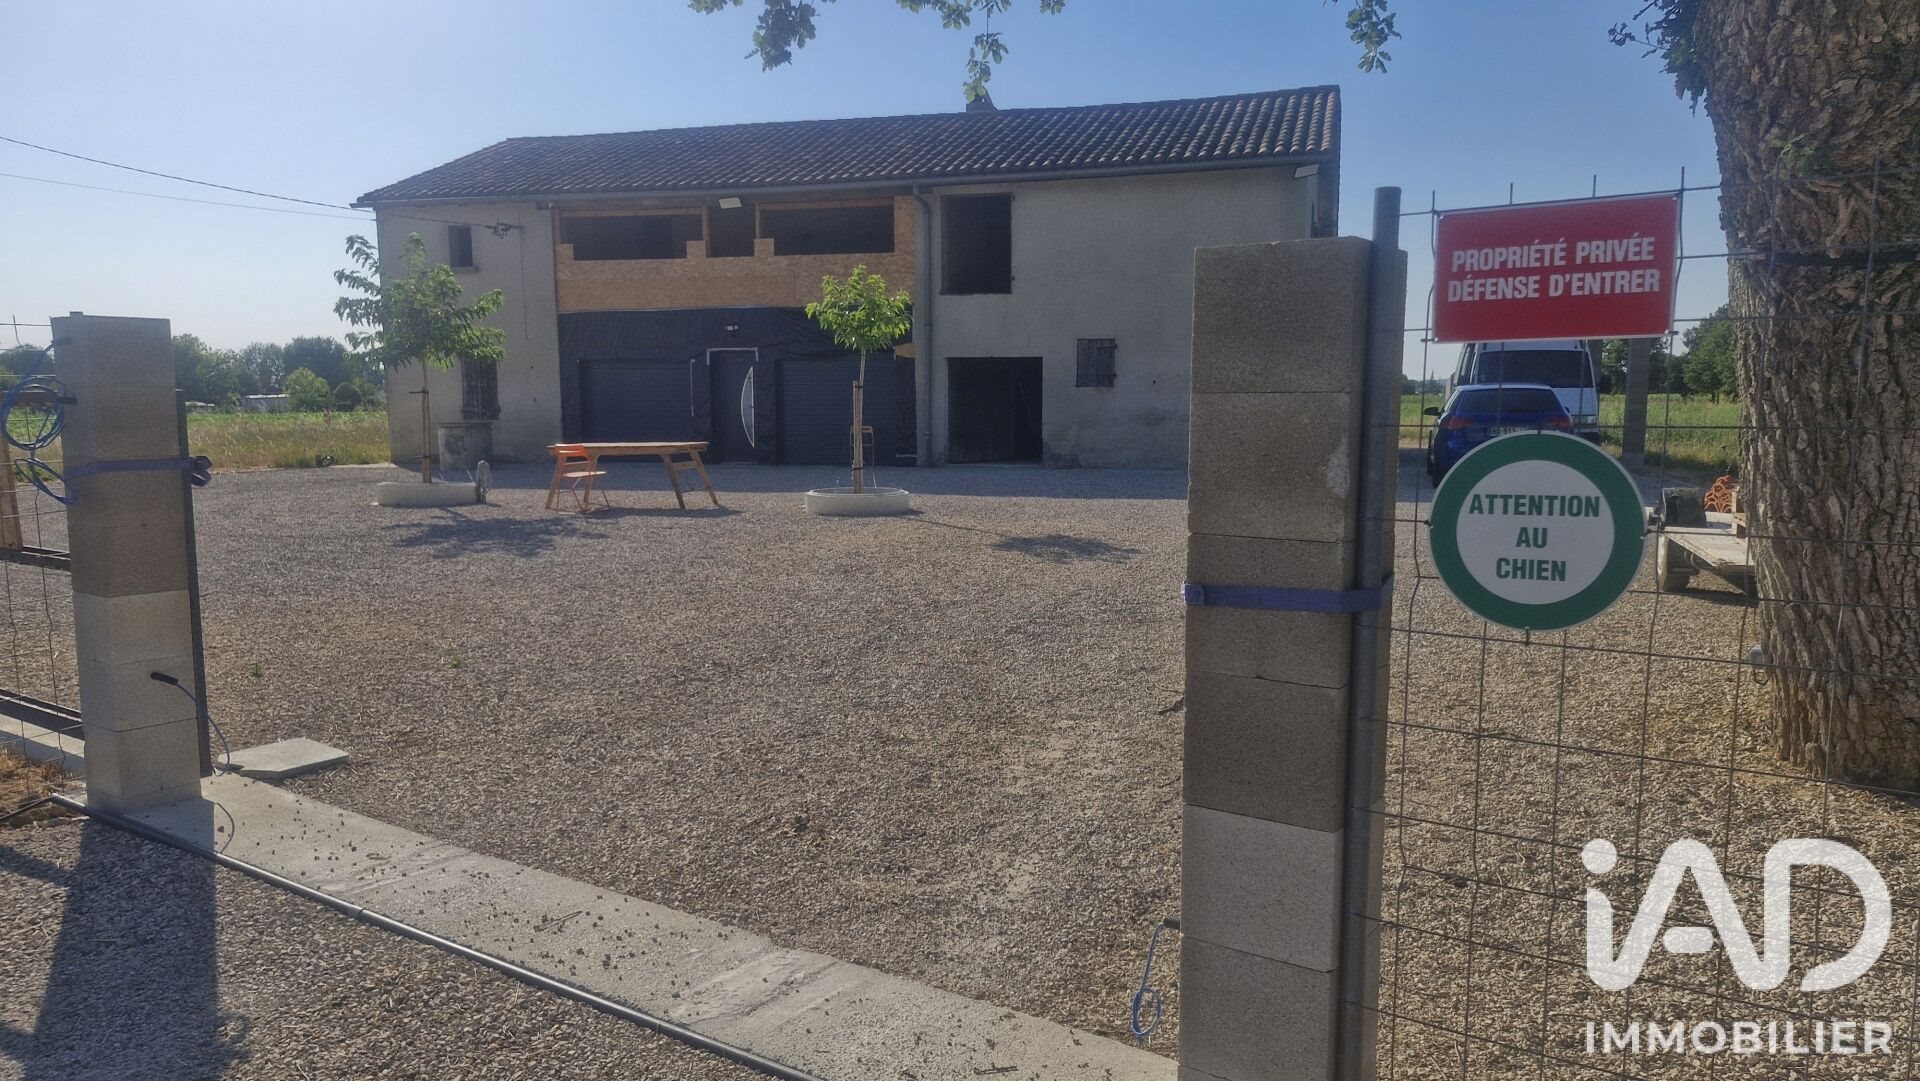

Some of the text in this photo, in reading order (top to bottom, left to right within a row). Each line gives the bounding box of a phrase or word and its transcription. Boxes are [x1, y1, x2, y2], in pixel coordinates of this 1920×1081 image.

[1452, 231, 1656, 272] PROPRIÉTÉ PRIVÉE
[1447, 269, 1660, 302] DÉFENSE D'ENTRER
[1468, 493, 1600, 518] ATTENTION
[1515, 526, 1548, 549] AU
[1495, 557, 1566, 582] CHIEN
